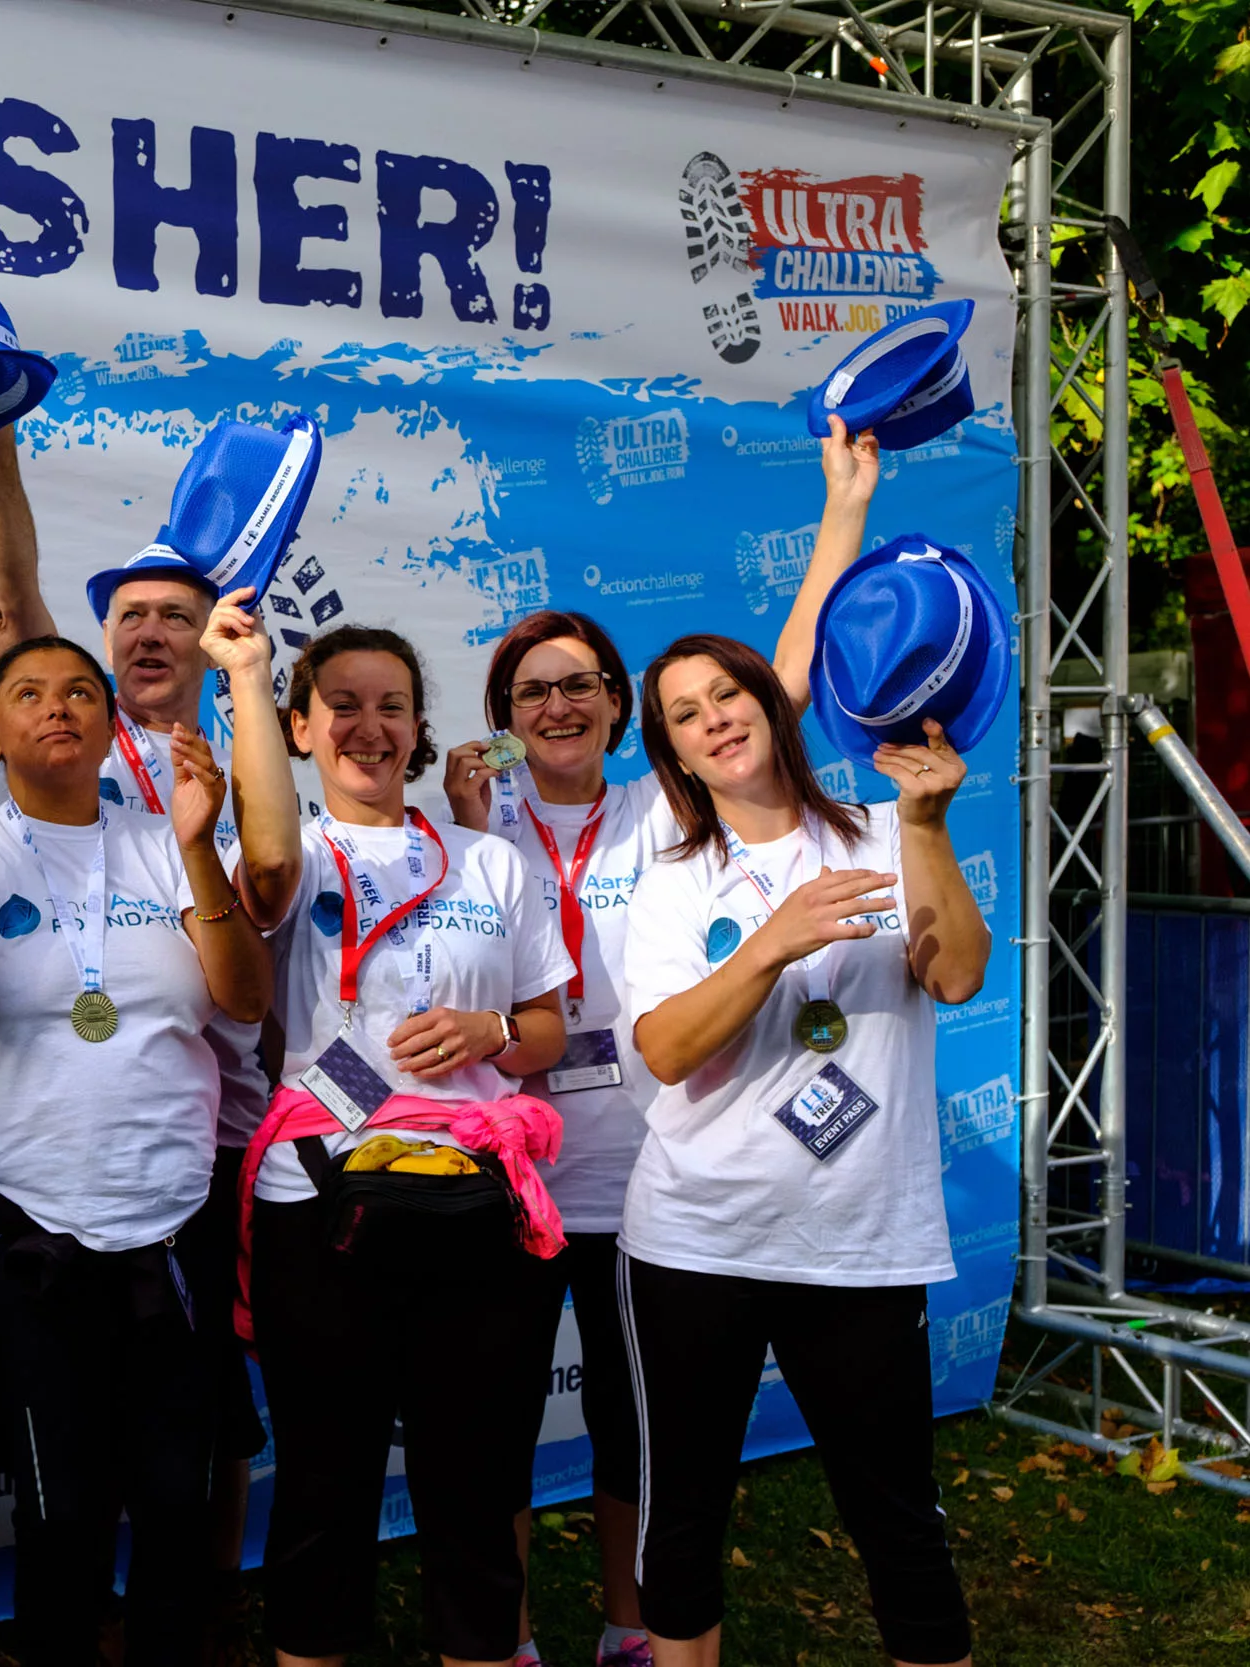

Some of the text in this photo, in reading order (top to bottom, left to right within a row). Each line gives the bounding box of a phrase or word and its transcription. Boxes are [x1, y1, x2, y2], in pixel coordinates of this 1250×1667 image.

[762, 189, 915, 253] ULTRA
[774, 251, 925, 294] CHALLENGE
[611, 416, 683, 449] ULTRA
[616, 444, 683, 470] CHALLENGE
[255, 465, 292, 528] THAMES BRIDGES TREK
[600, 571, 704, 596] actionchallenge
[356, 872, 382, 907] TREK
[812, 1096, 839, 1121] TREK
[951, 1084, 1008, 1122] ULTRA
[814, 1100, 867, 1149] EVENT PASS
